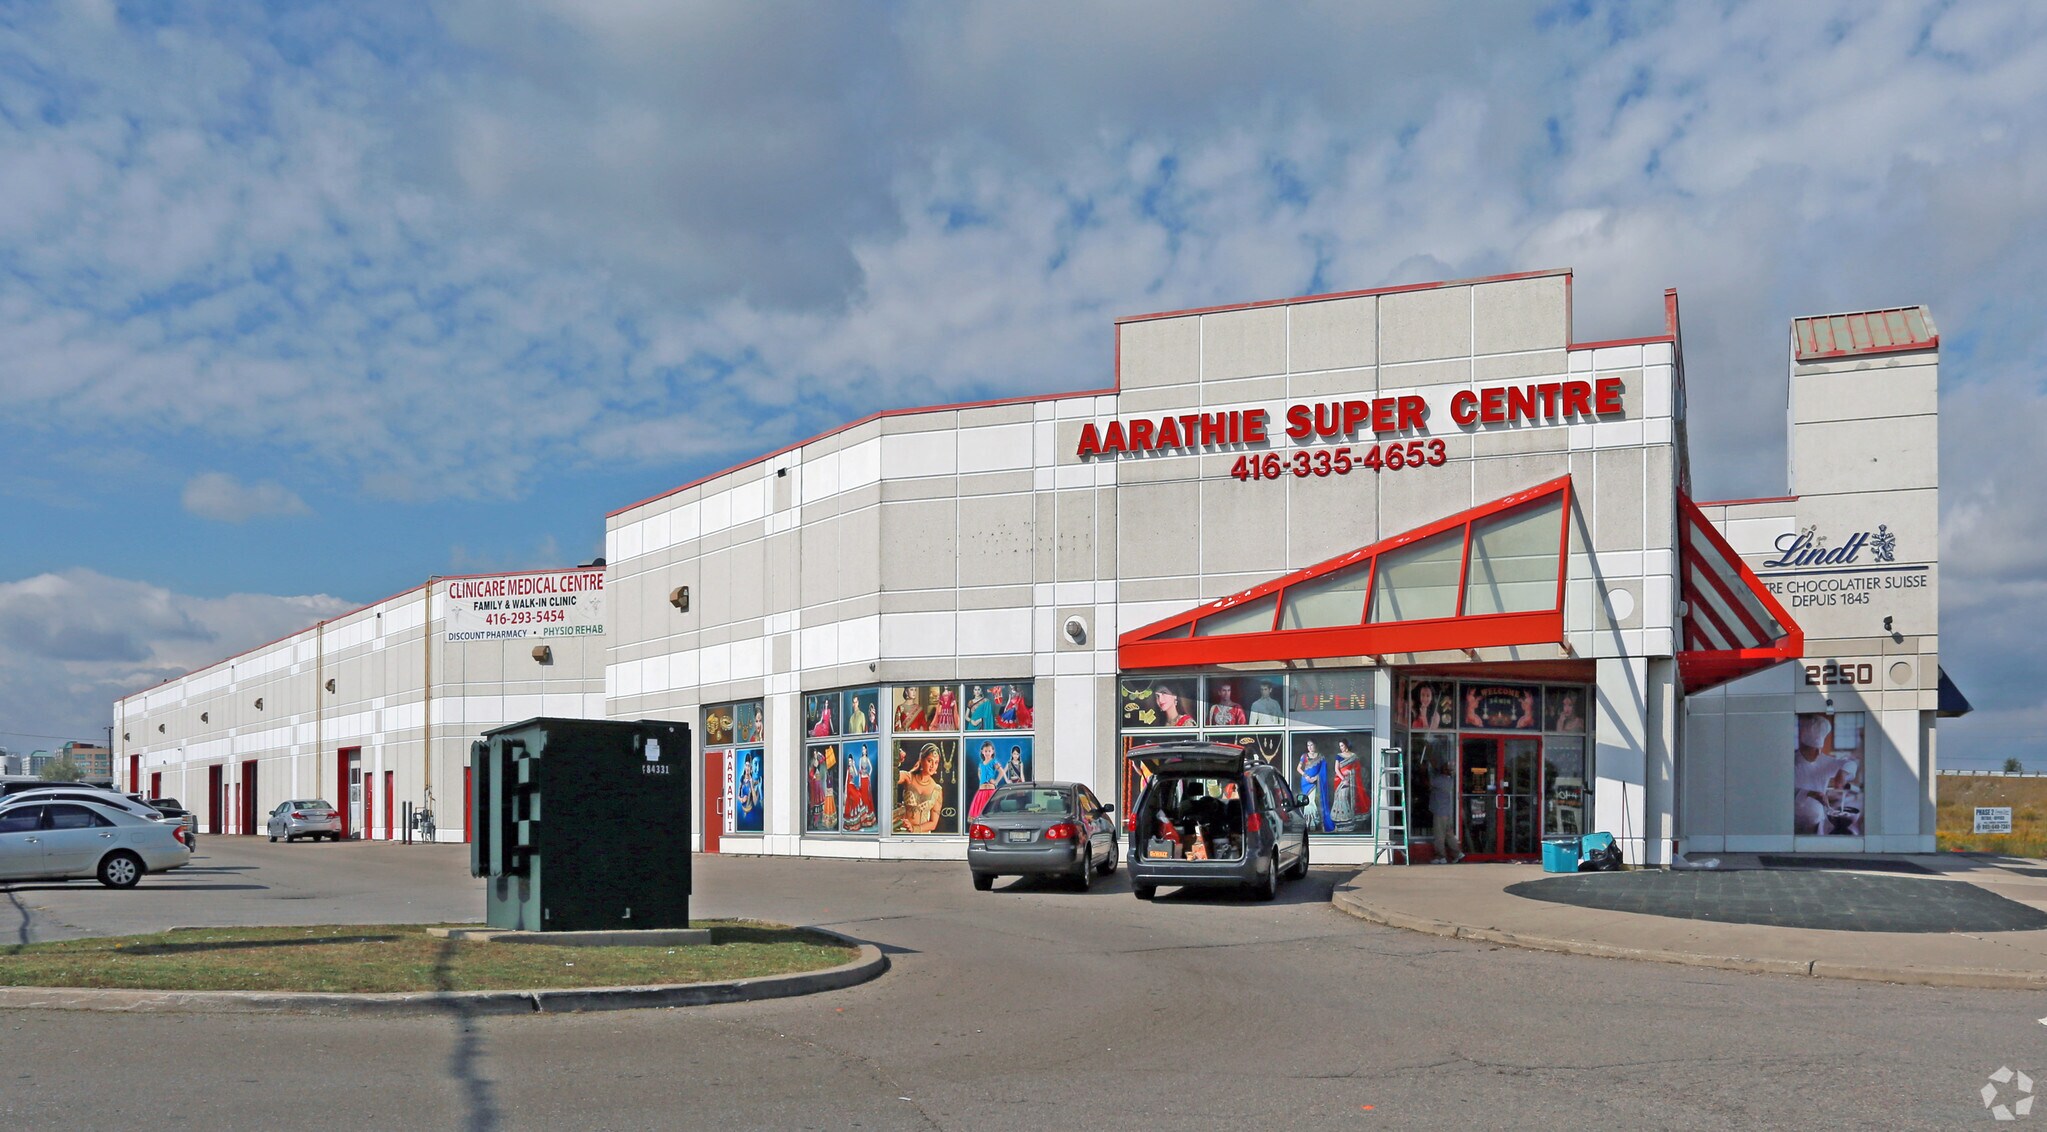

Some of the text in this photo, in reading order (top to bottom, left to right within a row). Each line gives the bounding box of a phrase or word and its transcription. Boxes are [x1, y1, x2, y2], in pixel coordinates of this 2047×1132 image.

[1076, 376, 1624, 457] AARATHIE SUPER CENTRE
[1230, 438, 1448, 481] 416-335-4653
[1763, 529, 1871, 568] Lindt
[449, 573, 604, 599] CLINICARE MEDICAL CENTRE
[1786, 577, 1881, 595] CHOCOLATIER
[1884, 575, 1927, 589] SUISSE
[473, 596, 577, 611] FAMILY & WALK-IN CLINIC
[1792, 592, 1870, 607] DEPUIS 1845
[485, 609, 565, 626] 416-293-5454
[448, 629, 527, 641] DISCOUNT PHARMACY
[543, 624, 604, 637] PHYSIO REHAB
[1804, 663, 1873, 686] 2250
[1480, 687, 1521, 698] WELCOME
